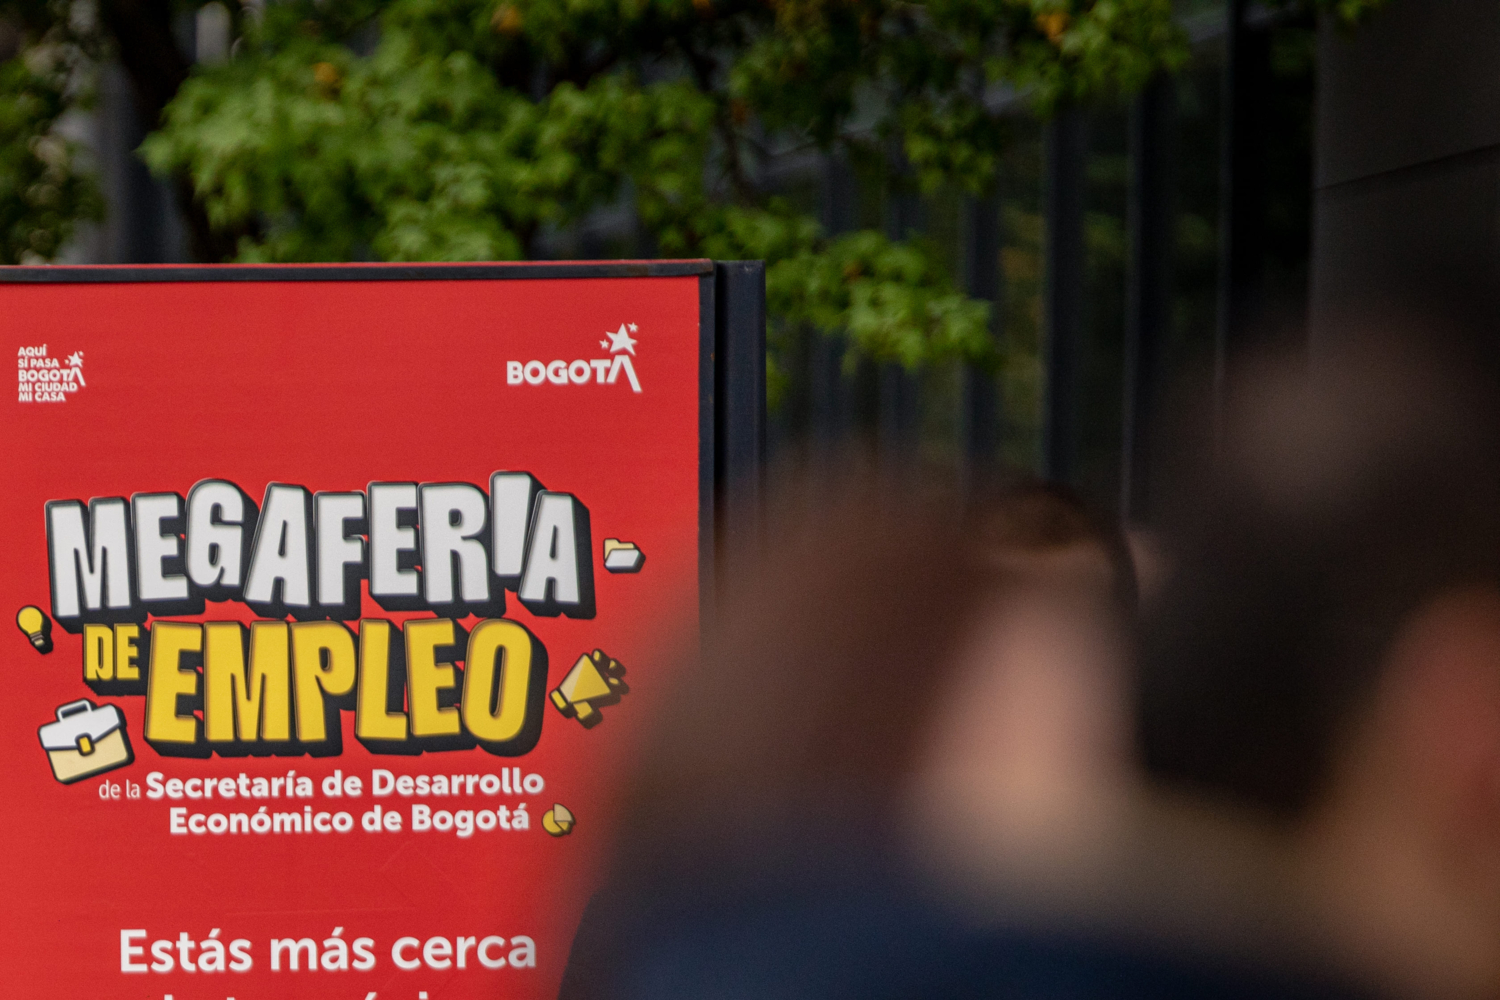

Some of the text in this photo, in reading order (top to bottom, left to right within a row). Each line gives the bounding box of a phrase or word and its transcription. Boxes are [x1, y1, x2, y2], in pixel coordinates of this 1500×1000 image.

[18, 344, 47, 357] AQUÍ
[30, 358, 60, 368] PASA
[18, 382, 78, 392] MI CIUDAD
[18, 392, 66, 402] MI CASA
[45, 470, 596, 633] MEGAFERIA
[83, 618, 548, 757] DE EMPLEO
[99, 767, 544, 799] de la Secretaría de Desarrollo
[170, 803, 530, 838] Económico de Bogotá
[120, 927, 536, 973] Estás más cerca
